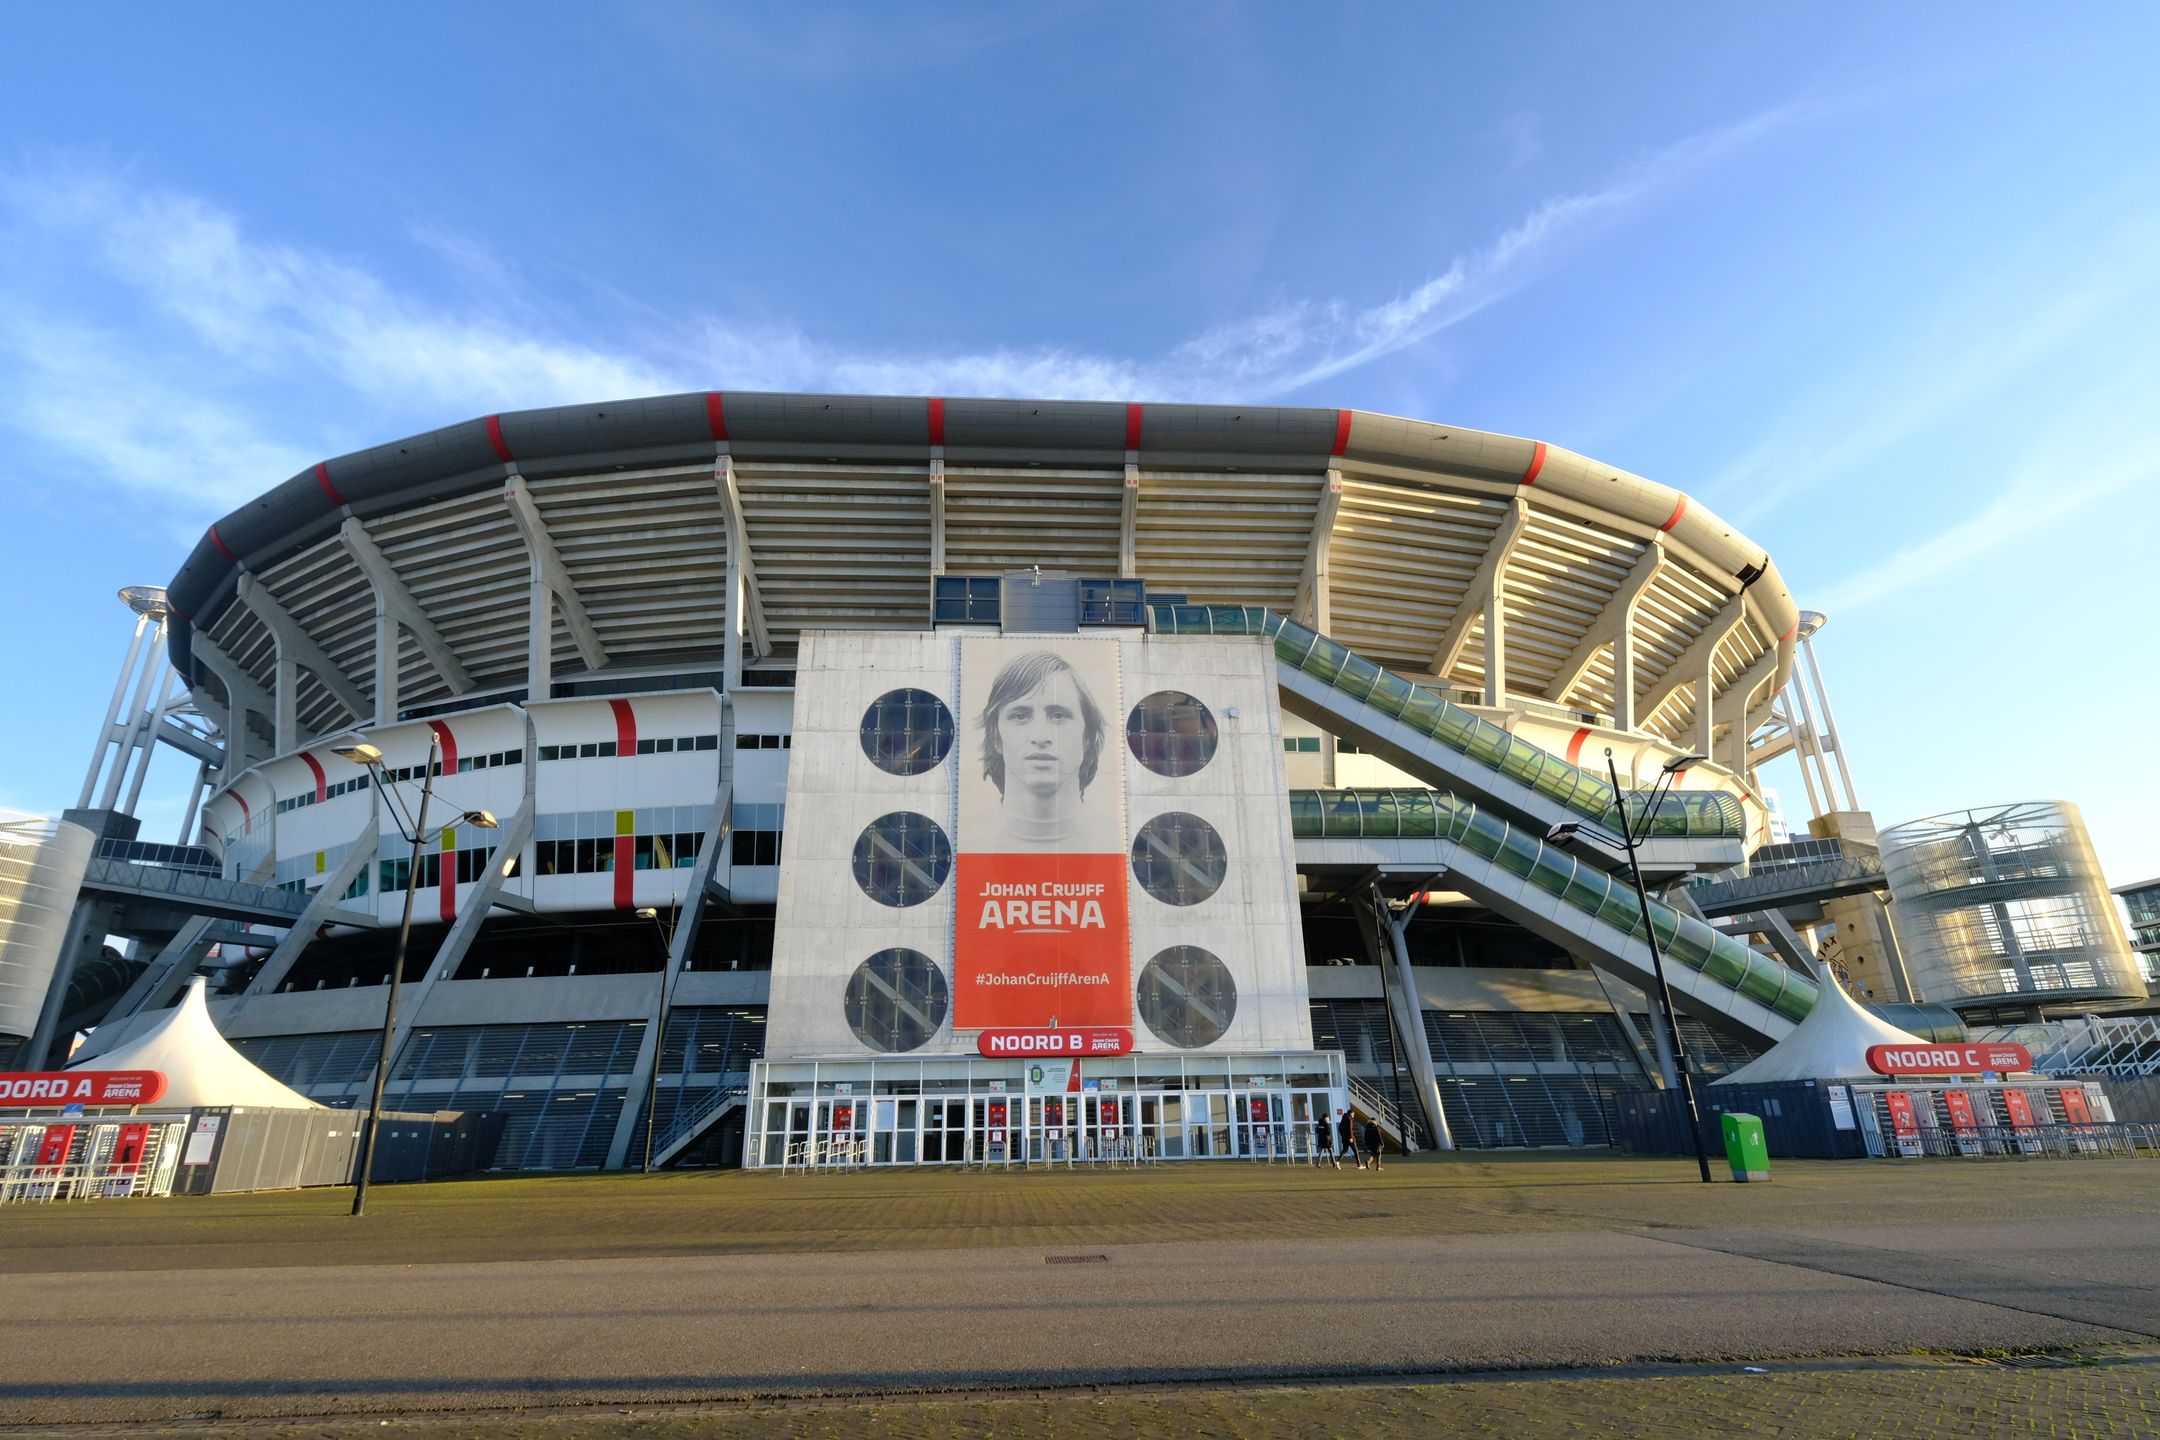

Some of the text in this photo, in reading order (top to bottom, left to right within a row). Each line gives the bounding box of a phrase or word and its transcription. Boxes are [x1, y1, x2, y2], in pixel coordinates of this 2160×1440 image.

[979, 882, 1037, 897] JOHAN
[978, 900, 1106, 929] ARENA
[975, 973, 1110, 988] #JohanCruijffArenA
[991, 1034, 1083, 1051] NOORD B
[1091, 1042, 1120, 1050] ARENA
[1885, 1050, 1980, 1067] NOORD C
[1991, 1057, 2020, 1066] ARENA
[73, 1079, 92, 1097] A
[102, 1088, 140, 1098] ARENA
